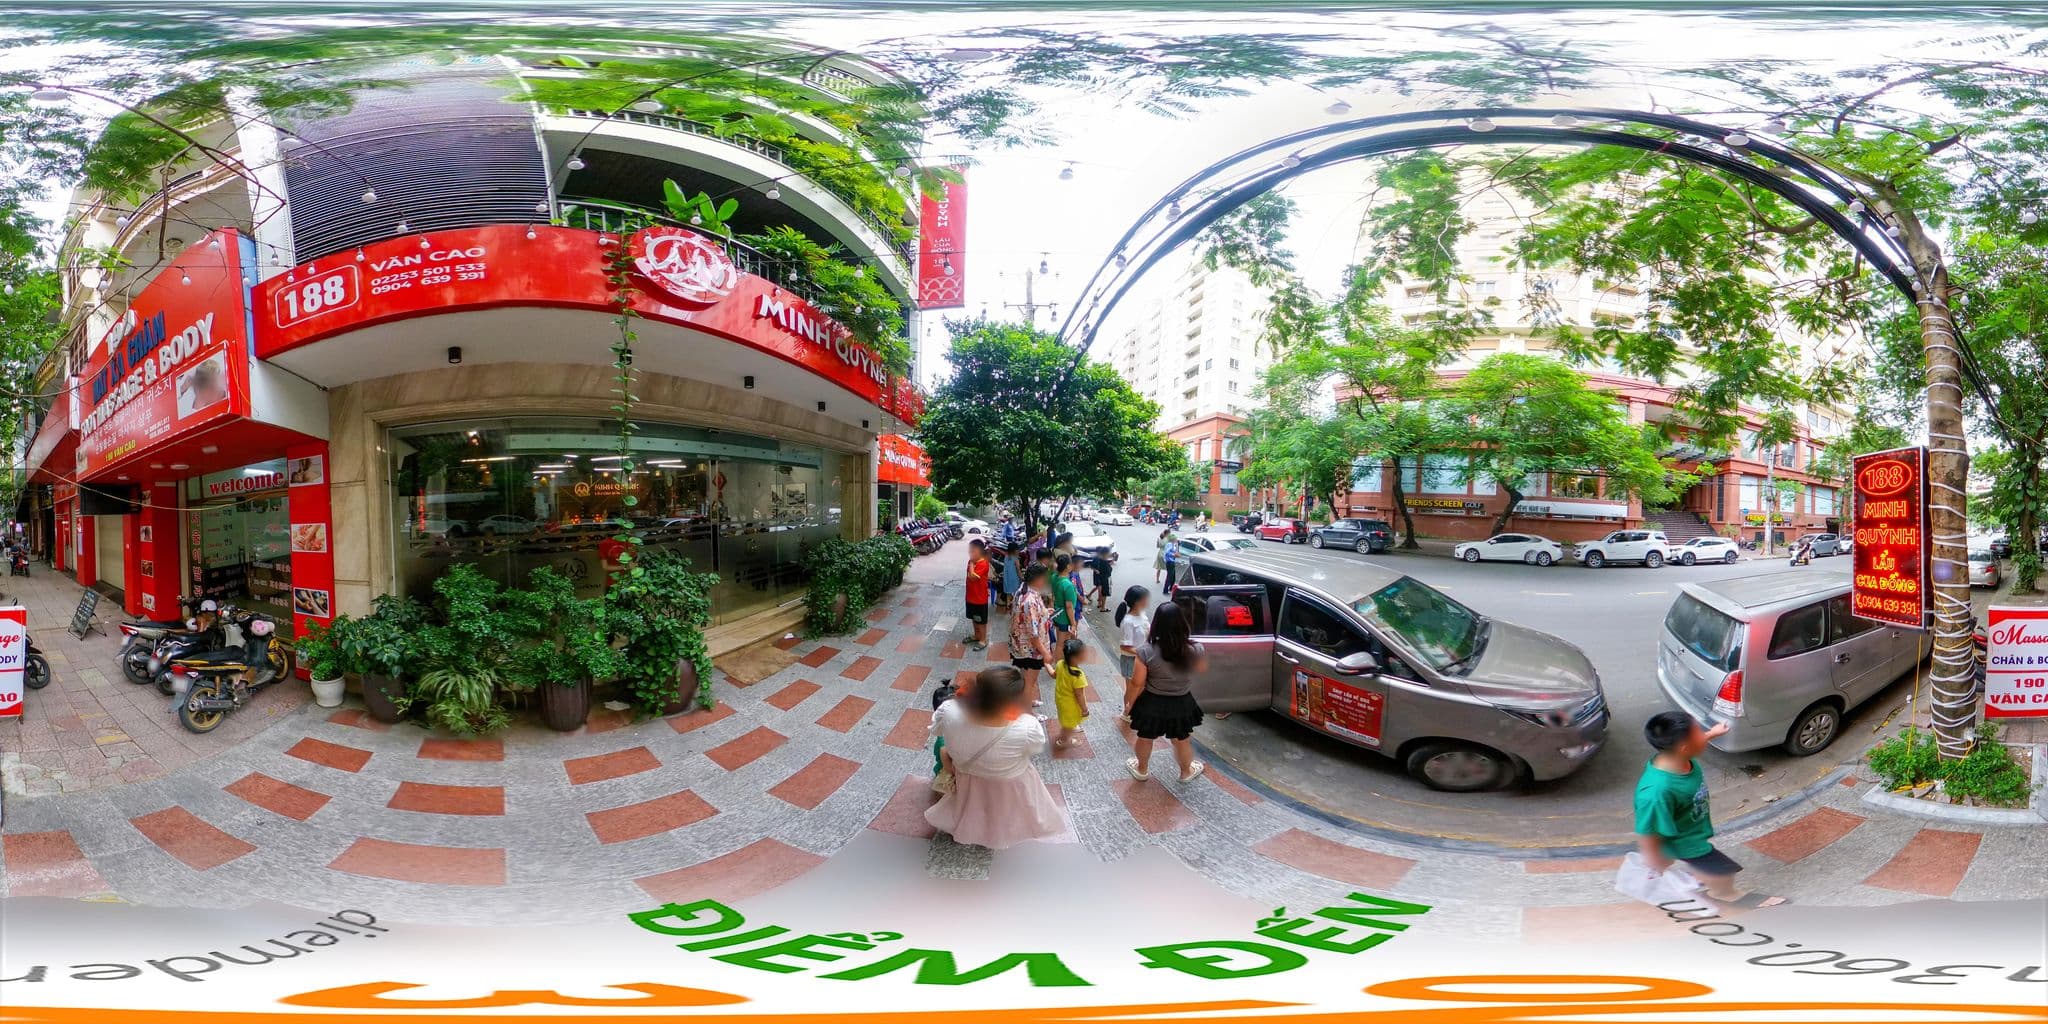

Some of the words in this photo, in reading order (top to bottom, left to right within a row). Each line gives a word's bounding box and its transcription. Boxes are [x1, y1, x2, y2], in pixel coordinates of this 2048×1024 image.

[370, 254, 422, 272] VĂN
[429, 247, 487, 261] CAO
[371, 270, 419, 286] 02253
[422, 265, 451, 276] 501
[454, 262, 487, 272] 533
[371, 281, 412, 295] 0904
[420, 274, 451, 285] 639
[457, 271, 485, 281] 391
[284, 275, 346, 320] 188
[757, 293, 831, 350] MINH
[144, 358, 158, 386] &
[159, 312, 215, 376] BODY
[209, 472, 285, 496] welcome
[1865, 465, 1904, 490] 188
[1433, 500, 1463, 508] SCREEN
[1863, 501, 1907, 518] MINH
[1900, 601, 1917, 615] 391
[2027, 656, 2034, 665] &
[2014, 678, 2045, 689] 190
